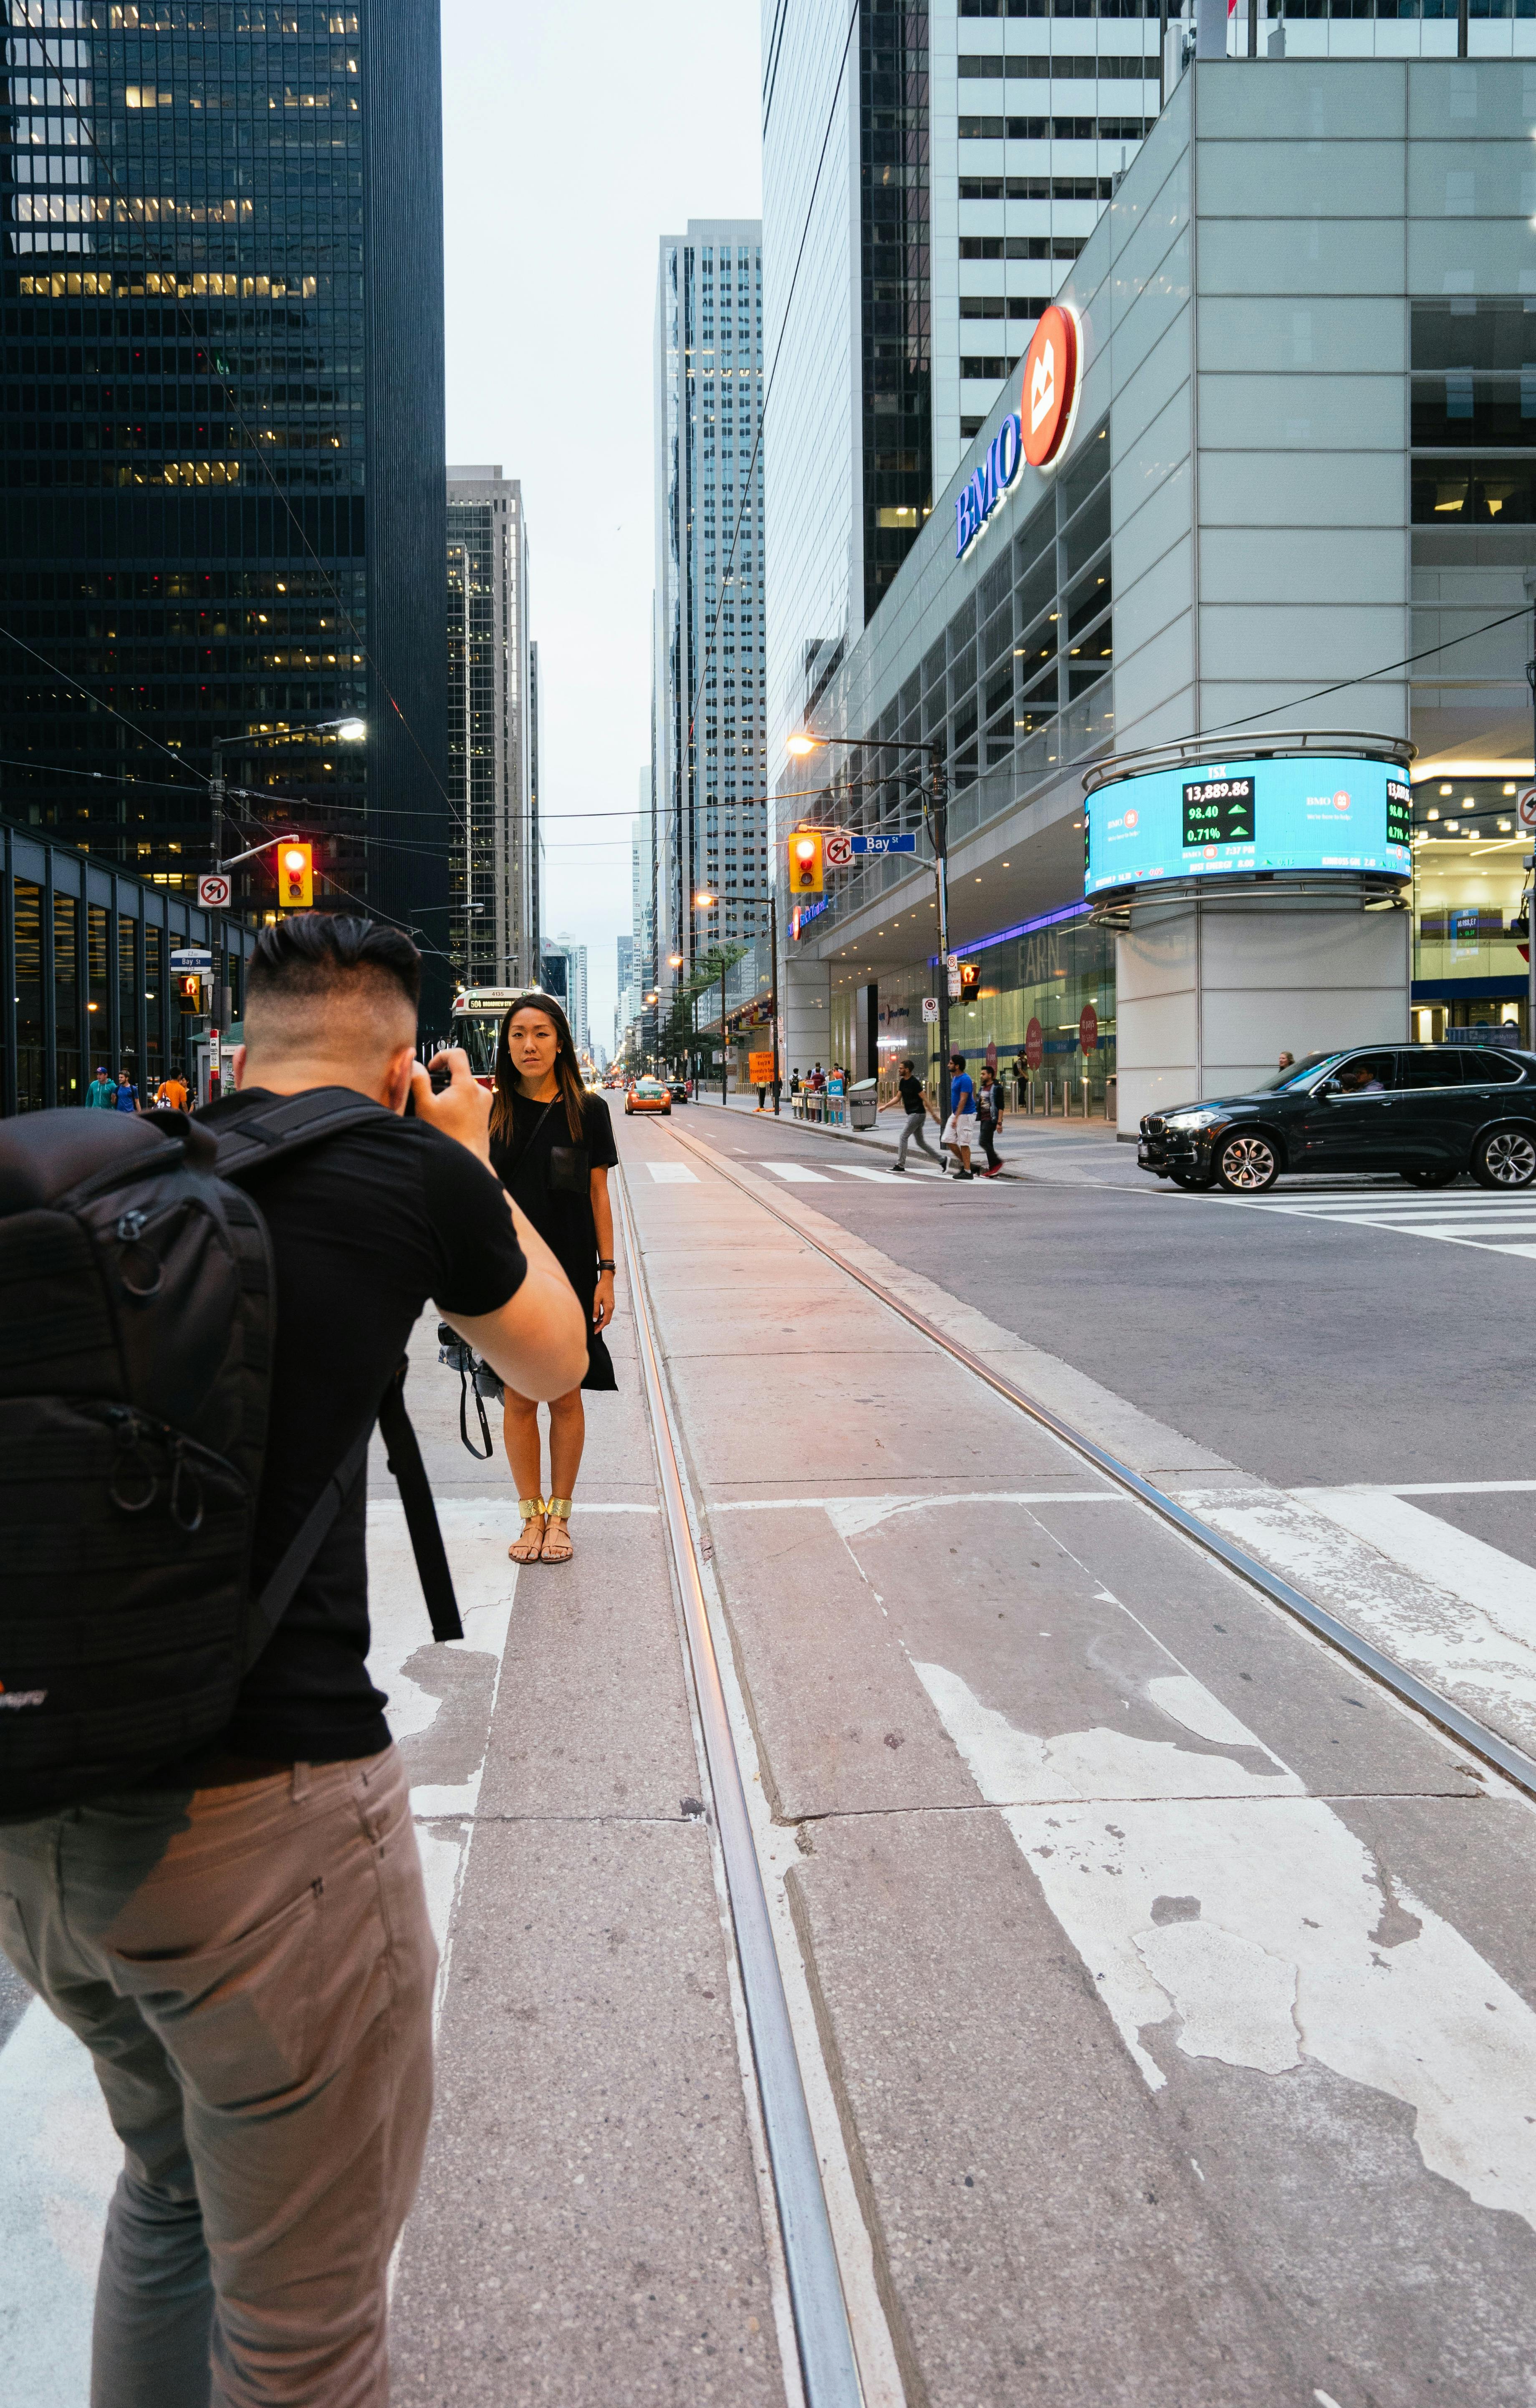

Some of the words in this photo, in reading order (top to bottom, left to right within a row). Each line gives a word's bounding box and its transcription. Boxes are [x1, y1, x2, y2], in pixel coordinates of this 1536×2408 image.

[955, 413, 1021, 558] BMO
[1208, 766, 1226, 778] TSX
[1186, 781, 1249, 802] 13,889.86
[1306, 797, 1331, 806] BMO
[1189, 806, 1218, 819] 98.40
[1187, 827, 1220, 841] 0.71%
[867, 837, 889, 852] Bay
[1225, 846, 1241, 855] 7:37
[1190, 863, 1204, 873] JUST
[1205, 860, 1233, 871] ENERGY
[1086, 1020, 1094, 1031] pays
